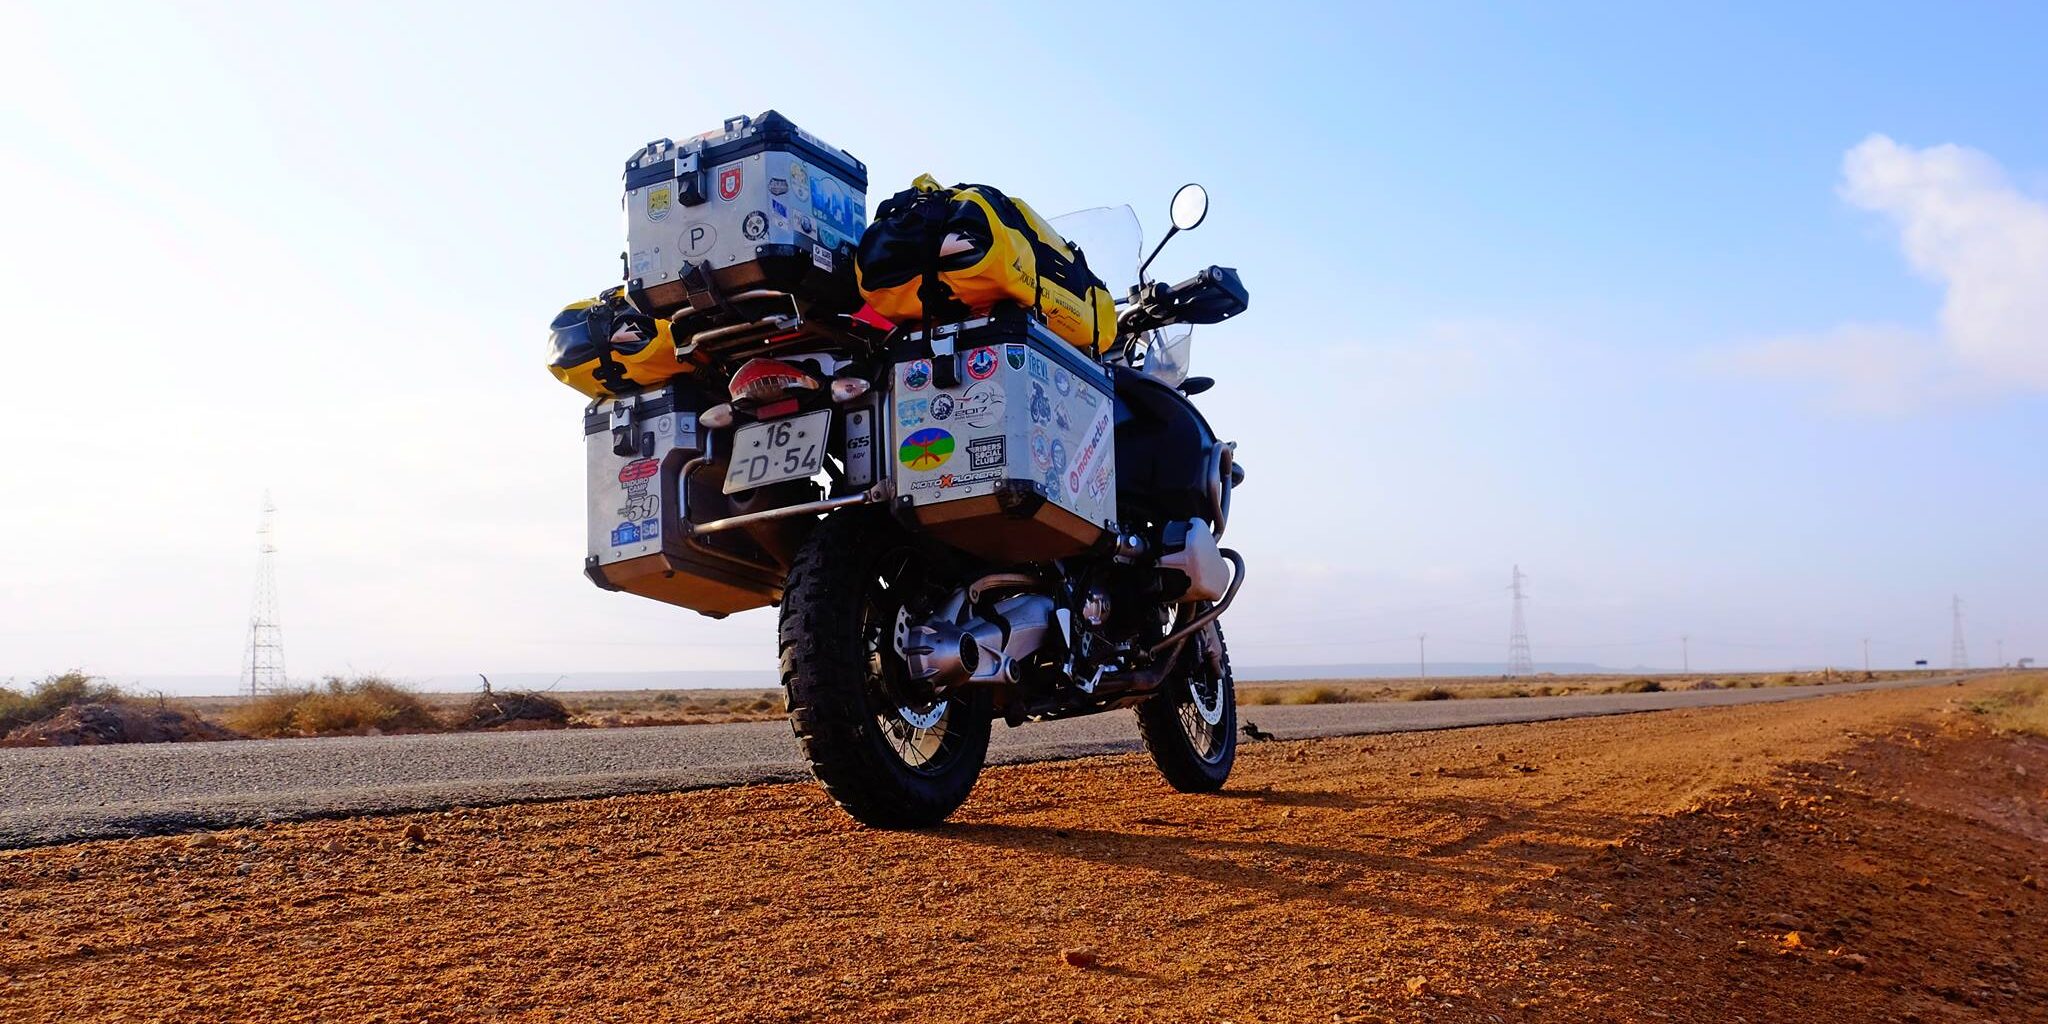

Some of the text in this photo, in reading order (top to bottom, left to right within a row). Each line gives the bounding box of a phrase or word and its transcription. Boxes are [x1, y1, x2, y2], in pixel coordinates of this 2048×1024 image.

[690, 227, 705, 251] P
[955, 406, 988, 417] 2017
[766, 421, 793, 450] 16
[974, 442, 1002, 453] RIDERS
[974, 450, 1002, 460] SOCIAL
